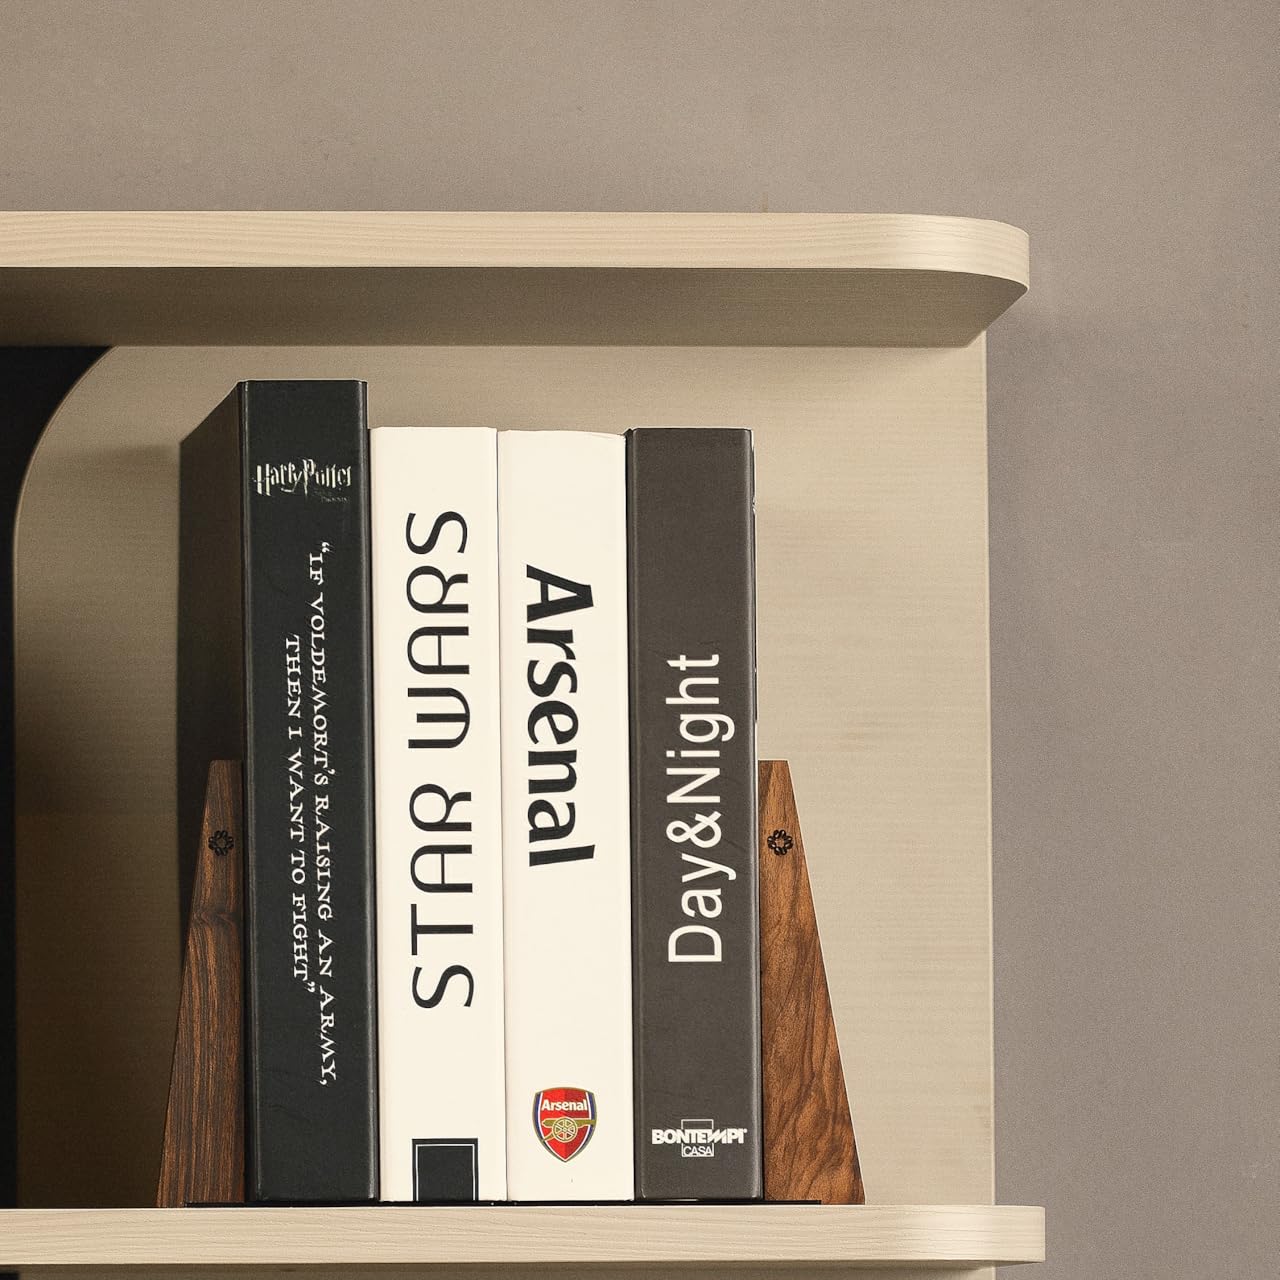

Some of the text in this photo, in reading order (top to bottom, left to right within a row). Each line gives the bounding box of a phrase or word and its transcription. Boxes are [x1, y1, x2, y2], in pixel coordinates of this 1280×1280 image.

[286, 634, 301, 719] THEN
[525, 564, 595, 868] Arsenal
[288, 726, 303, 740] I
[406, 510, 475, 1009] STAR WARS
[288, 747, 306, 843] WANT
[665, 653, 737, 966] Day&Night
[290, 850, 306, 885] TO
[314, 794, 334, 921] RAISING
[317, 929, 335, 978] AN
[319, 985, 337, 1086] ARMY,
[541, 1099, 588, 1111] Arsenal
[683, 1146, 713, 1156] CASA
